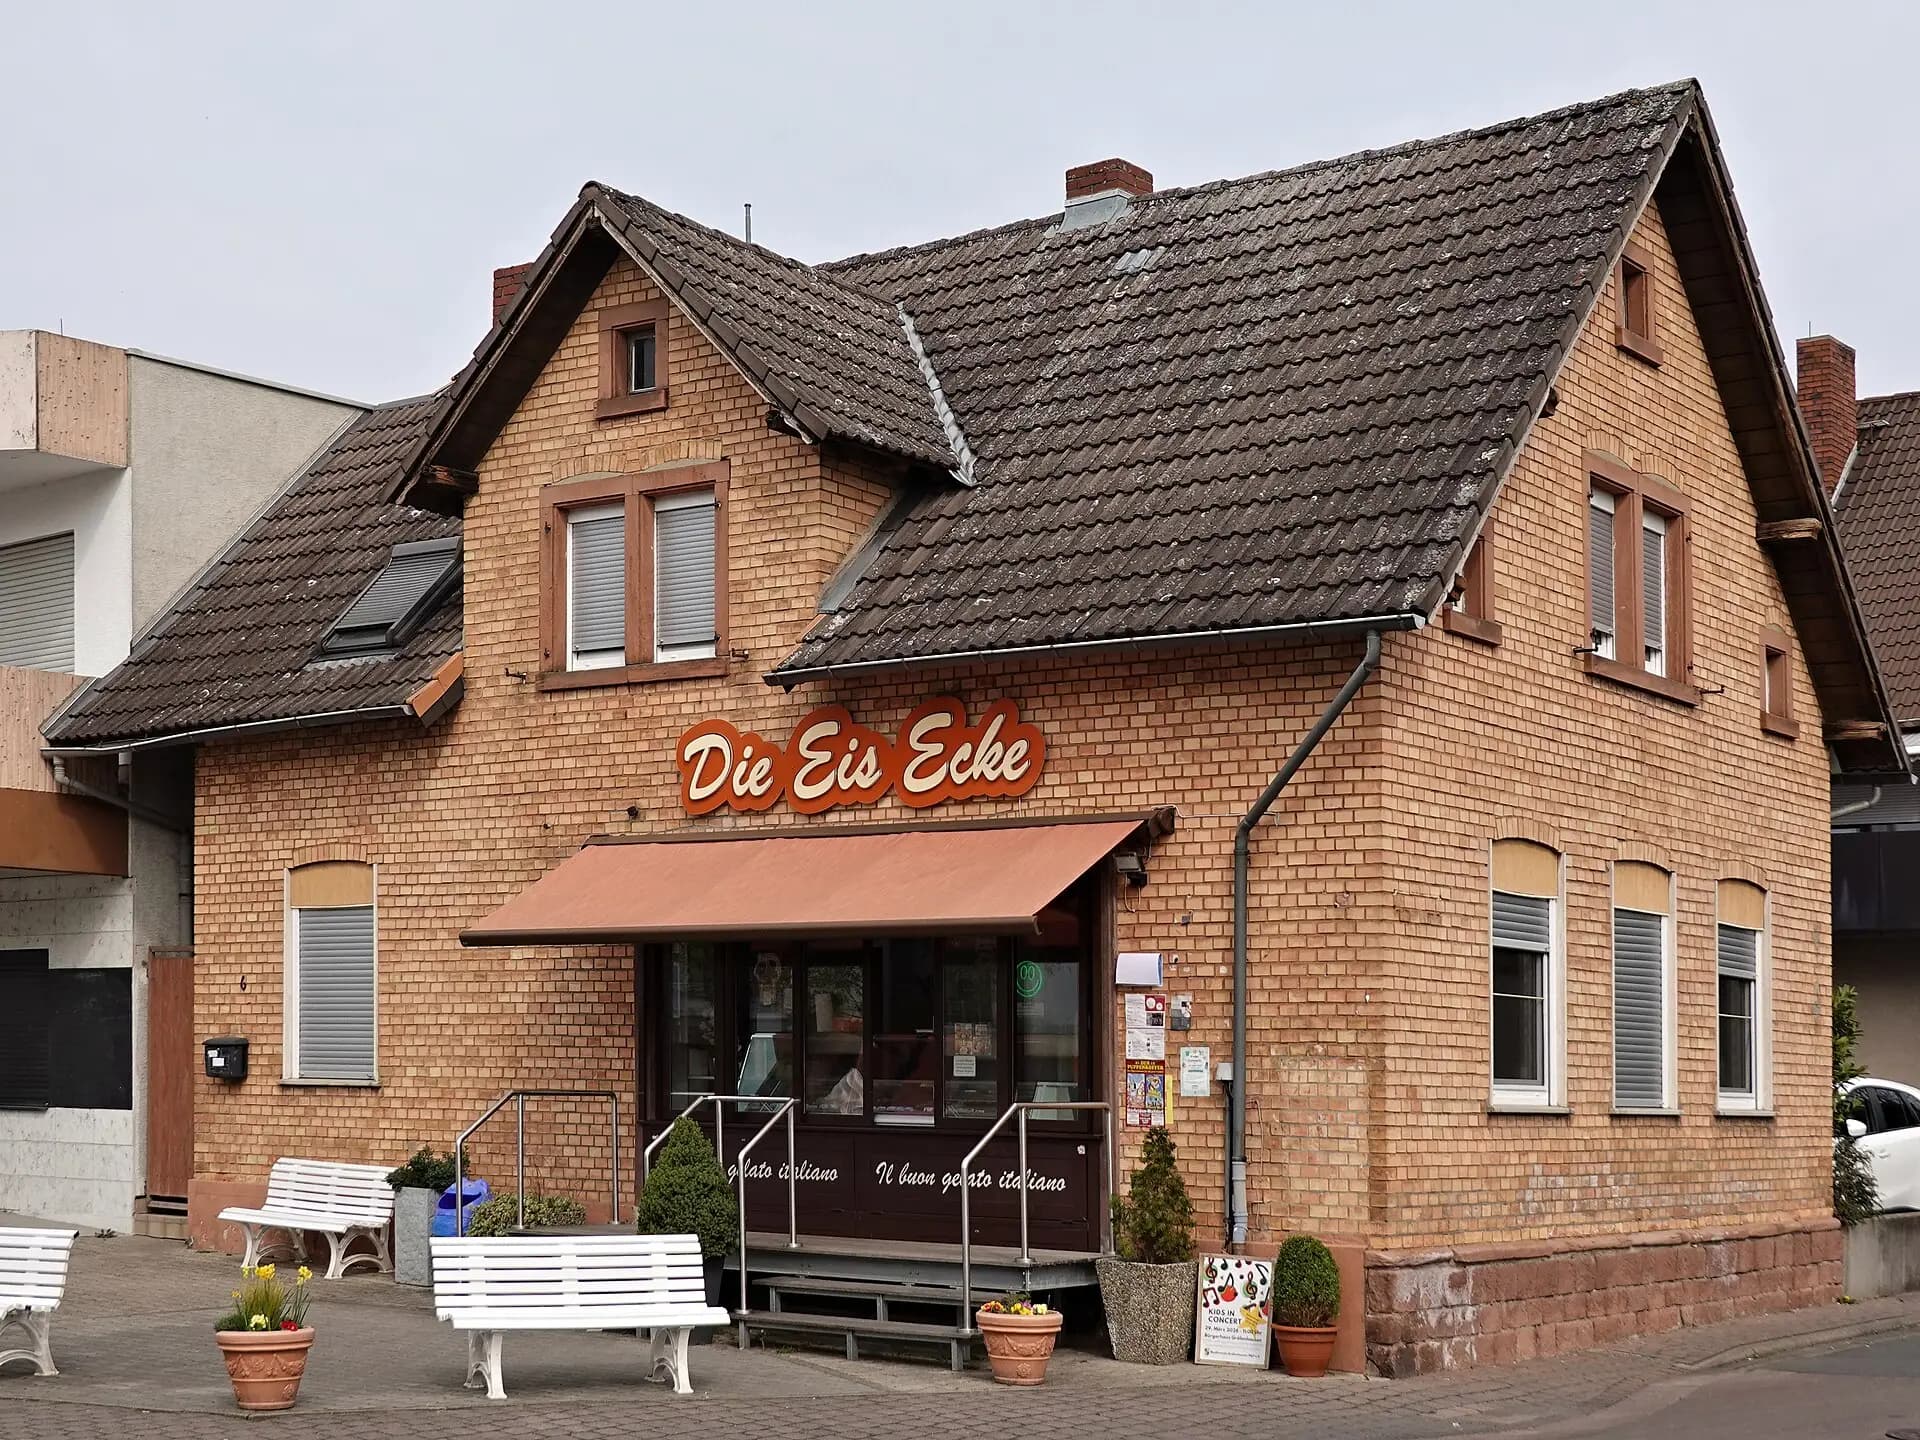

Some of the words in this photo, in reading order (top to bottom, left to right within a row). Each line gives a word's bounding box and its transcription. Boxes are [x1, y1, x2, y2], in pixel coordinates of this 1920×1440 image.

[684, 733, 774, 800] Die
[793, 720, 883, 799] Eis
[903, 712, 1030, 793] Ecke
[240, 975, 247, 992] 6
[875, 1161, 894, 1185] Il
[898, 1162, 936, 1186] buon
[942, 1169, 993, 1194] geato
[1208, 1316, 1242, 1324] CONCERT
